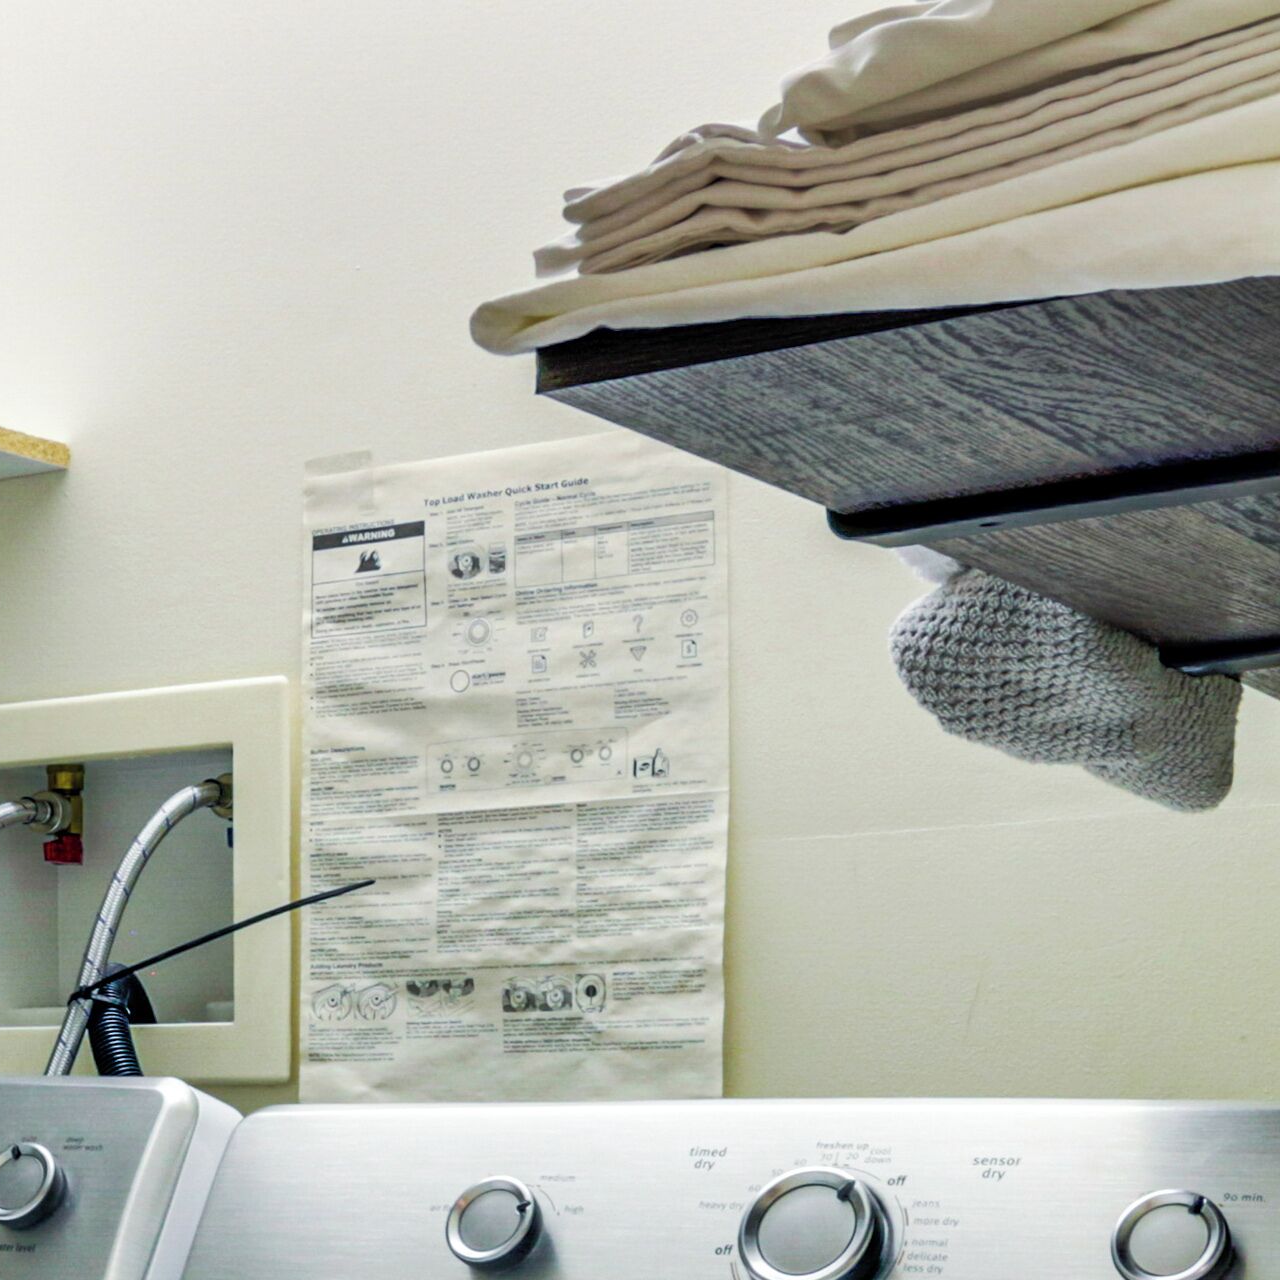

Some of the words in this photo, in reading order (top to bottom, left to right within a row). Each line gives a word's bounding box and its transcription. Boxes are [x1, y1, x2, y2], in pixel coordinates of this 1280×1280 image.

[424, 499, 440, 508] Top
[442, 495, 465, 504] Load
[468, 489, 503, 501] Washer
[505, 484, 532, 496] Quick
[535, 481, 559, 491] Start
[561, 477, 590, 488] Guide
[350, 529, 396, 543] WARNING
[690, 1146, 728, 1158] timed
[816, 1142, 853, 1150] freshen
[856, 1143, 869, 1151] up
[694, 1159, 716, 1171] dry
[973, 1155, 1021, 1167] sensor
[982, 1167, 1006, 1181] dry
[887, 1175, 908, 1186] off
[1223, 1193, 1238, 1202] 90
[564, 1205, 584, 1215] high
[942, 1216, 960, 1227] dry
[15, 1243, 37, 1252] level
[912, 1239, 948, 1247] normal
[715, 1244, 734, 1256] off
[907, 1252, 949, 1261] delicate
[903, 1264, 924, 1272] less
[927, 1265, 944, 1275] dry
